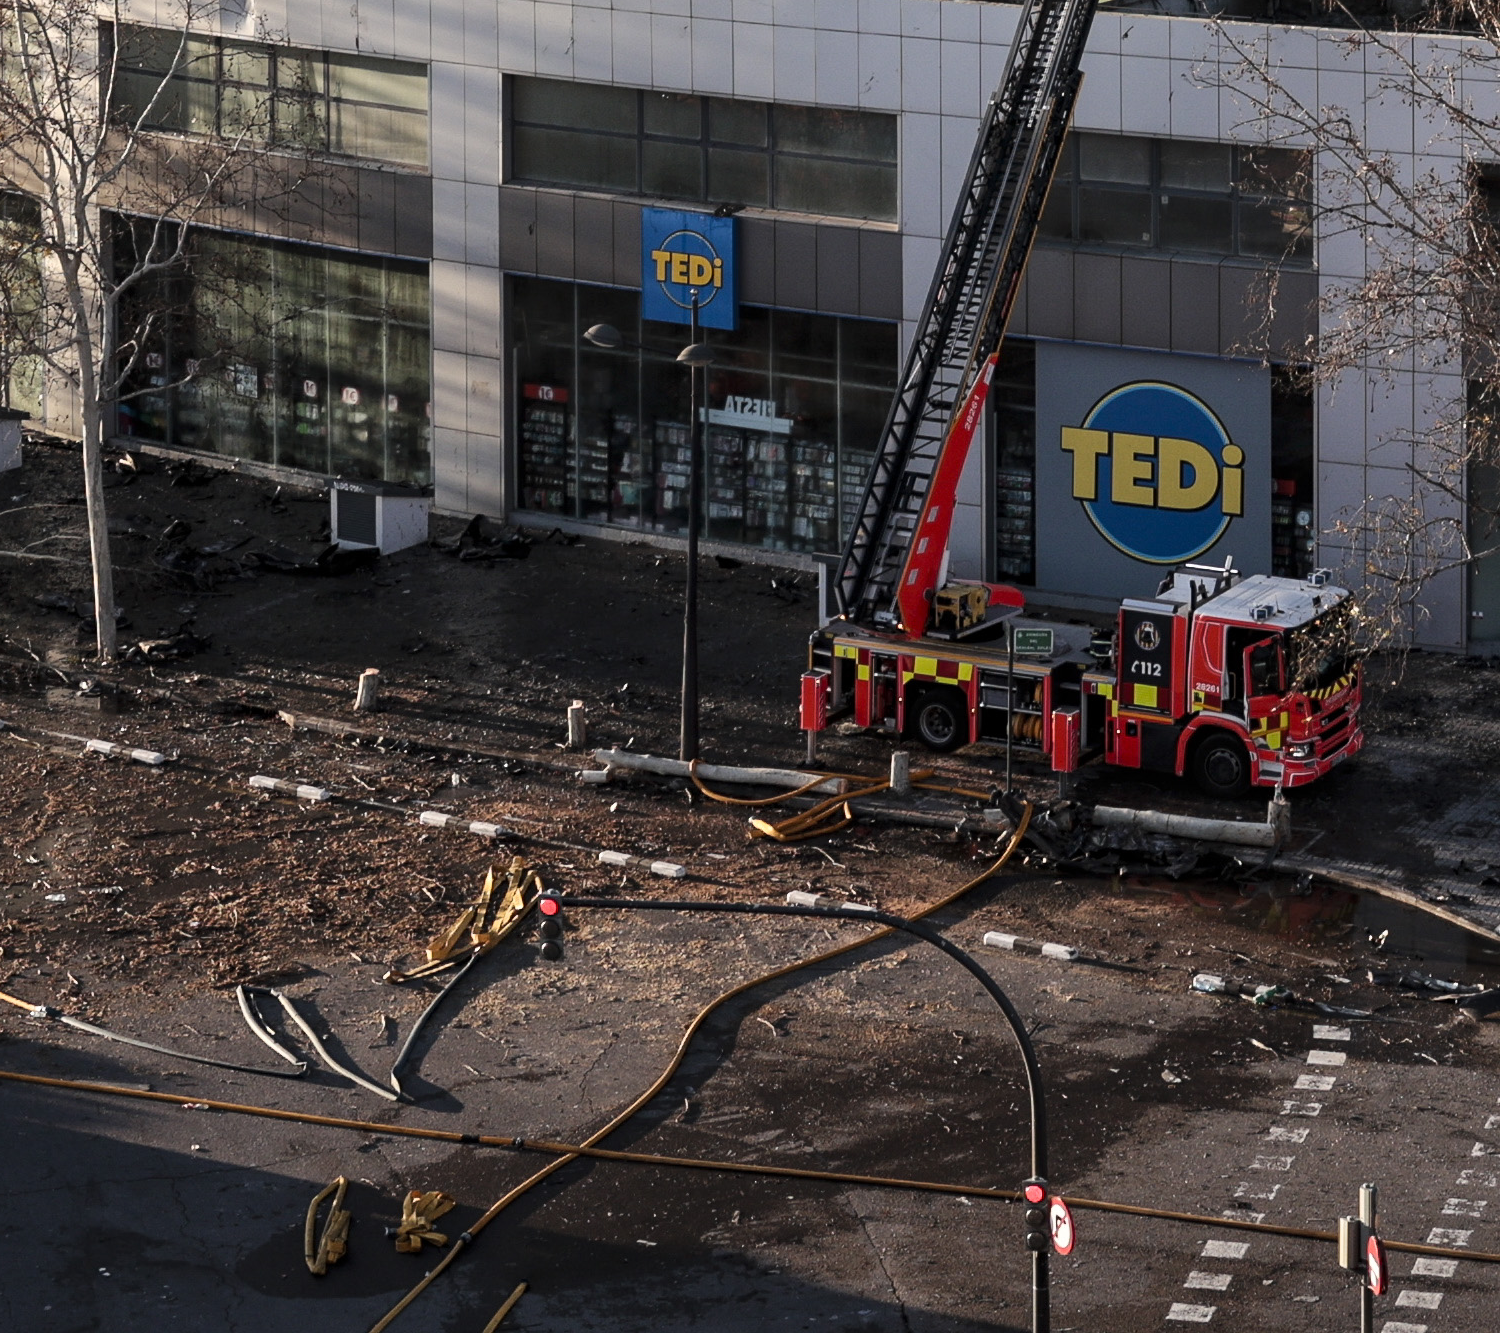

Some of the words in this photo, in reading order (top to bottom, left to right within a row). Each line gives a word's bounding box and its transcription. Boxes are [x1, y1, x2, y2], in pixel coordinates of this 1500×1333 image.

[651, 249, 723, 289] TEDi
[1060, 424, 1246, 518] TEDi
[1141, 661, 1162, 677] 112
